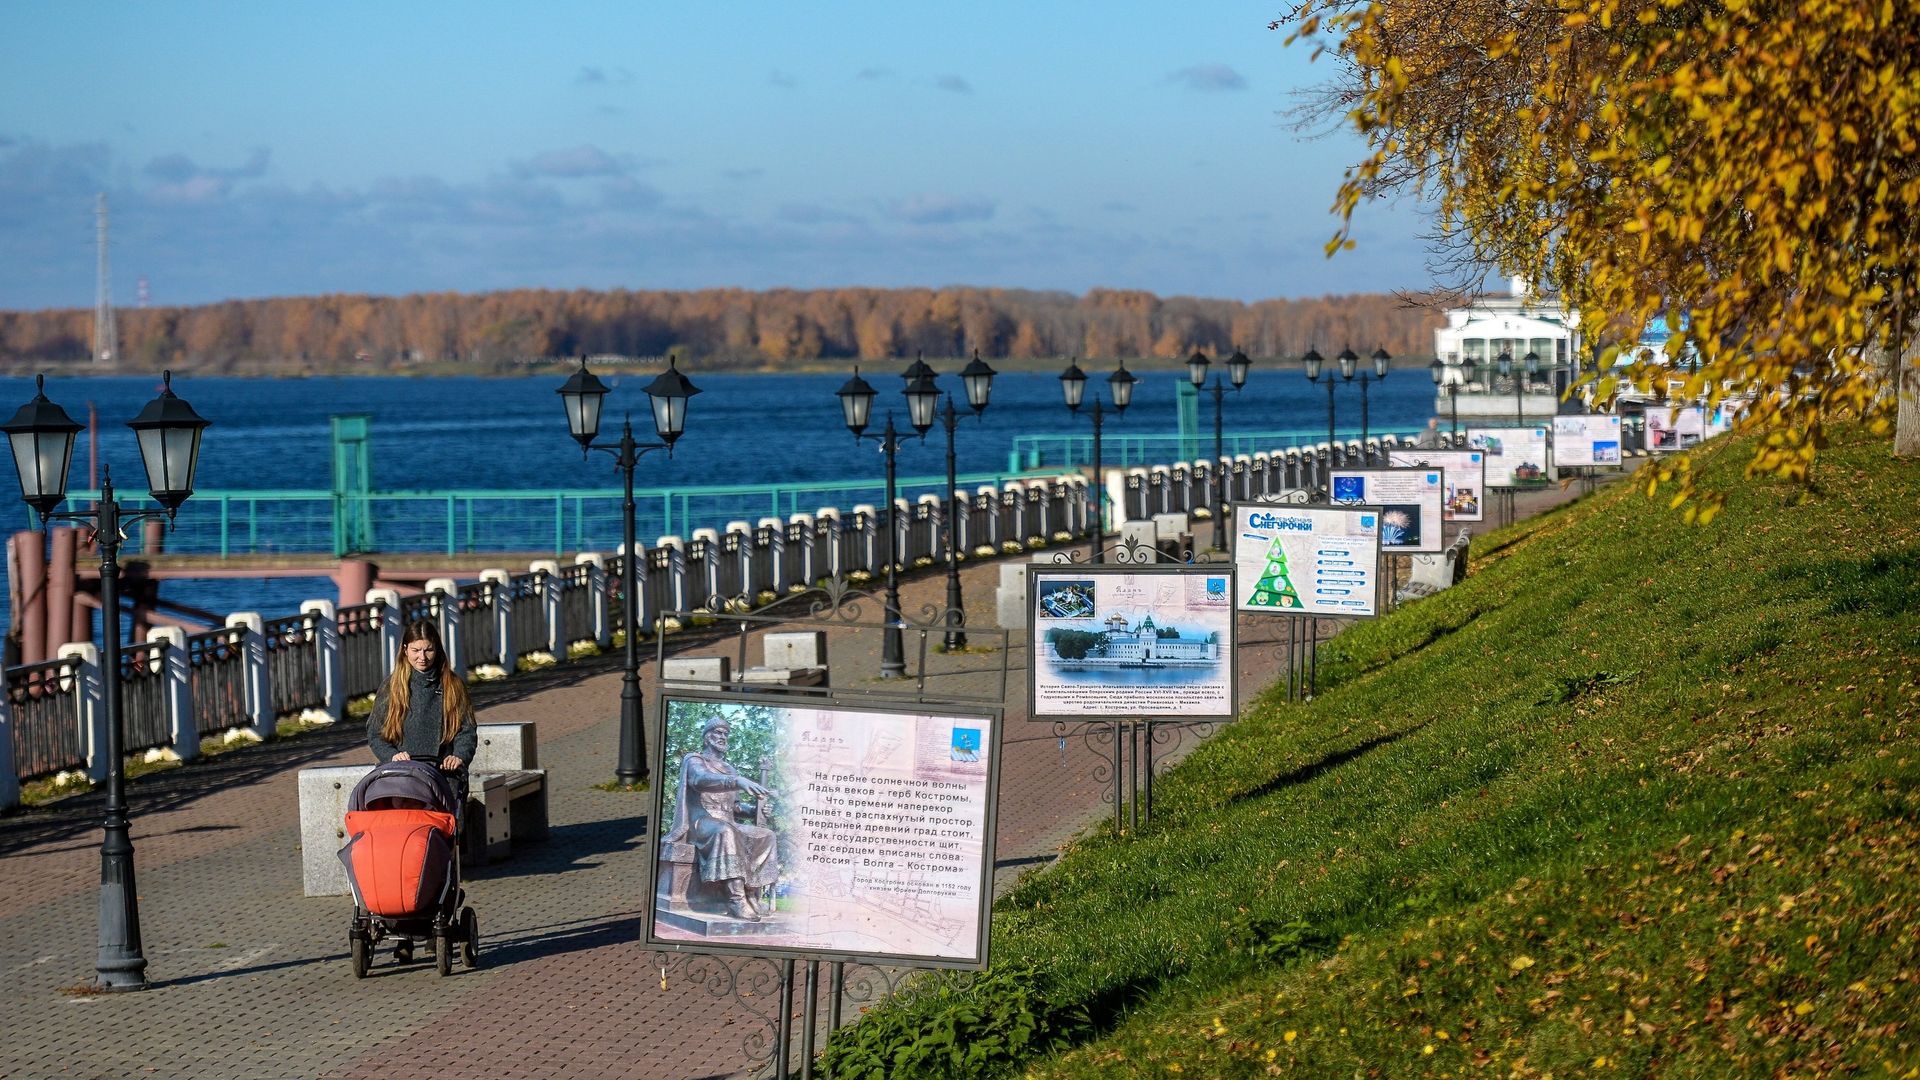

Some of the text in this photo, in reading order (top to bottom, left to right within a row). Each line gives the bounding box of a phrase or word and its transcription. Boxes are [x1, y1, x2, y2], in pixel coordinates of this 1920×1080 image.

[815, 772, 967, 790] На гребне солнечной волны
[808, 783, 841, 793] Ладья
[844, 787, 875, 796] веков
[888, 789, 911, 799] герб
[915, 791, 972, 803] Костромы,
[826, 796, 953, 814] Что времени наперекор
[801, 806, 842, 817] Плывёт
[855, 812, 925, 823] распахнутый
[929, 817, 976, 827] простор.
[802, 818, 862, 830] Твердыней
[864, 824, 910, 834] древний
[914, 828, 937, 836] град
[811, 831, 829, 840] Как
[832, 833, 935, 847] государственности
[808, 842, 826, 852] Где
[829, 845, 875, 855] сердцем
[879, 849, 925, 859] вписаны
[806, 854, 850, 865] «Россия
[863, 858, 894, 868] Волга
[907, 861, 964, 873] Кострома»
[874, 878, 905, 886] Кострома
[918, 888, 957, 896] Долгоруким
